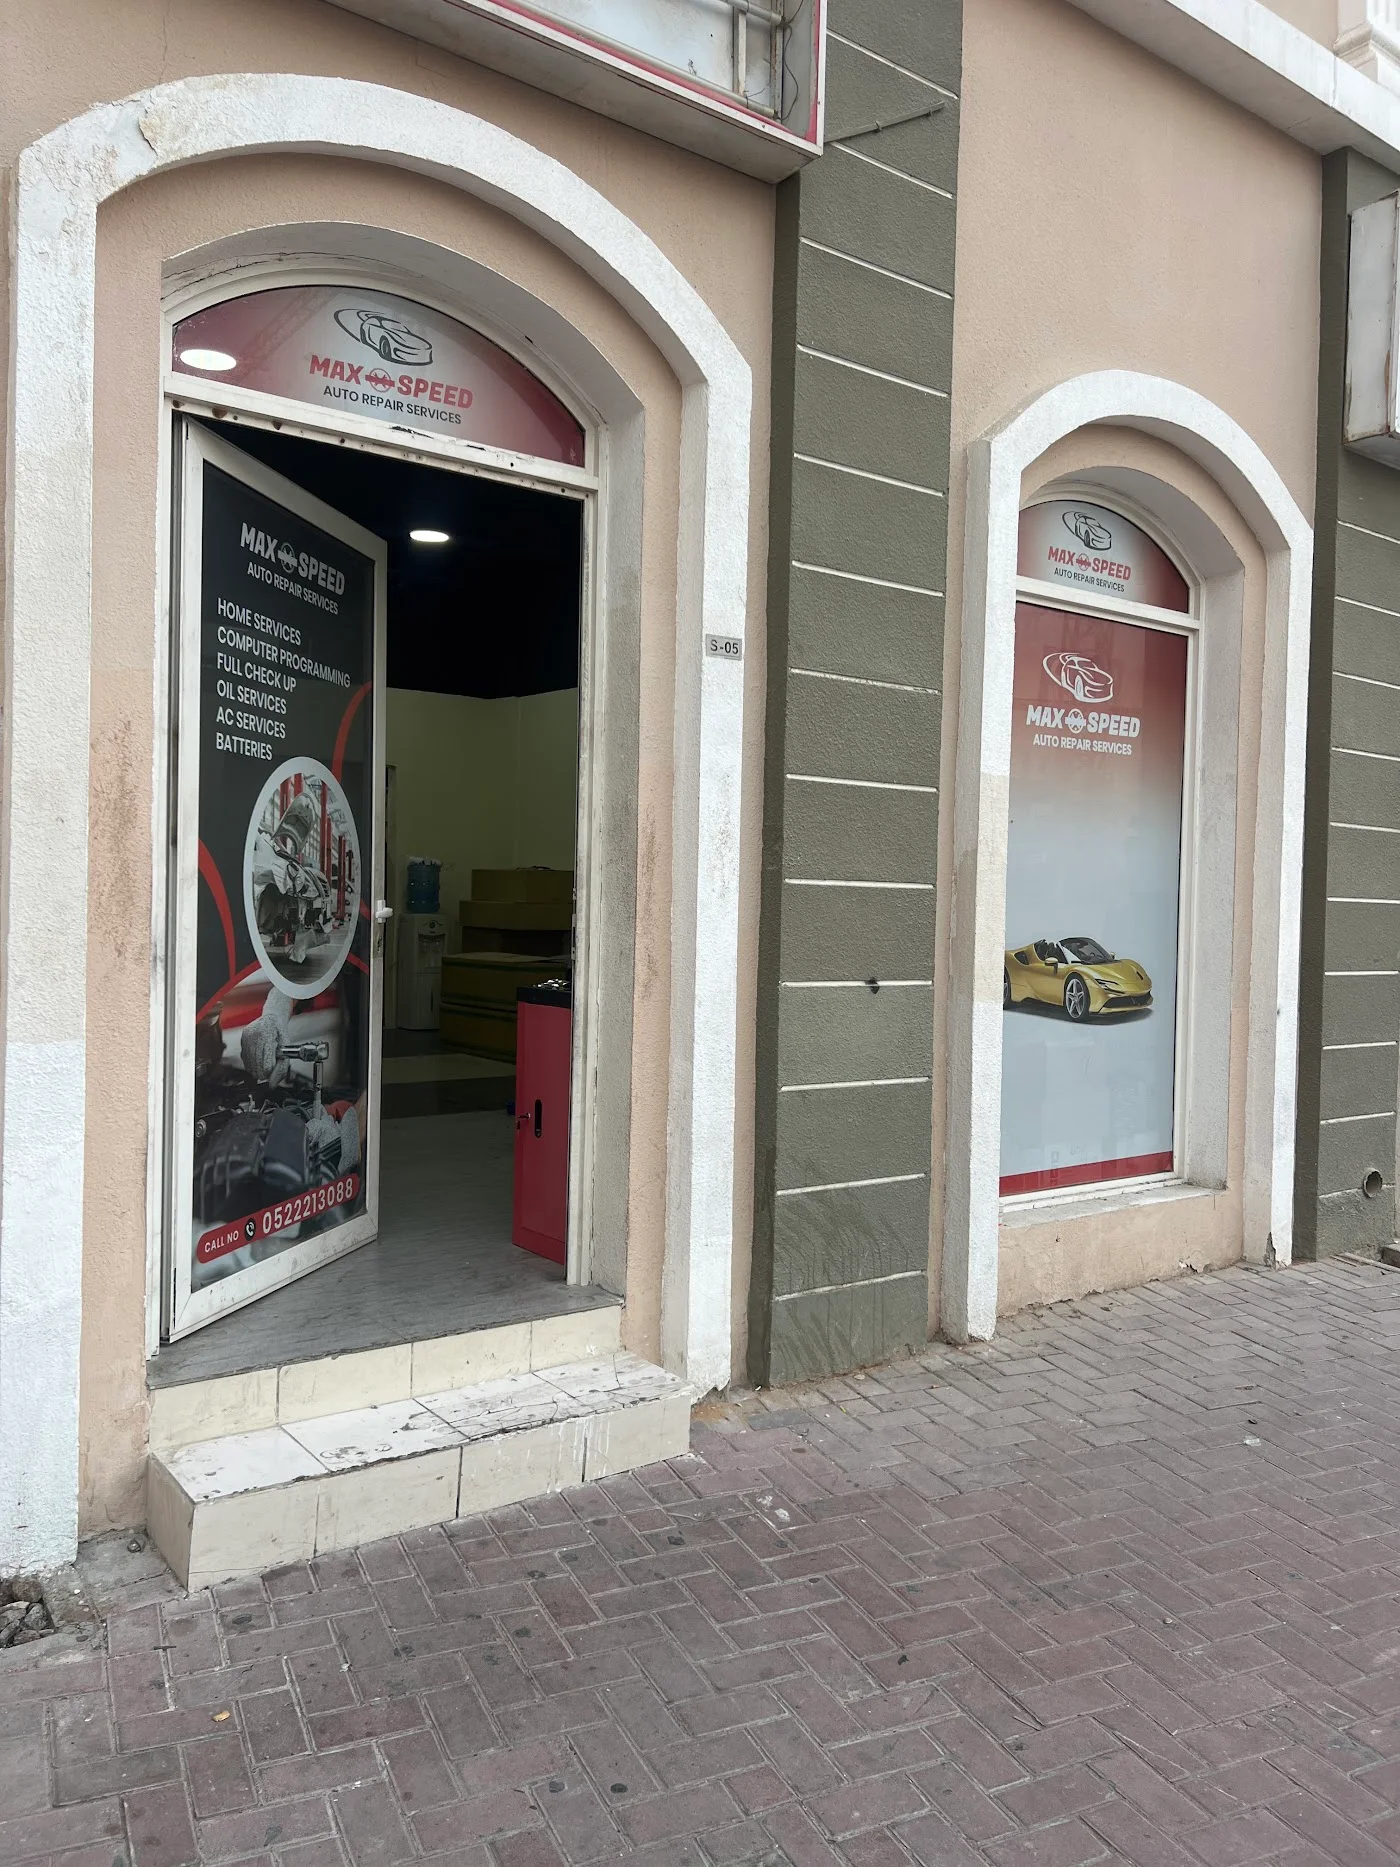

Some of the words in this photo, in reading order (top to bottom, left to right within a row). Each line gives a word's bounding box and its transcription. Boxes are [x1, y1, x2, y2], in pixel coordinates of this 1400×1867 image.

[309, 354, 364, 385] MAX
[397, 374, 473, 409] SPEED
[323, 385, 358, 403] AUTO
[362, 393, 403, 412] REPAIR
[406, 403, 461, 424] SERVICES
[240, 523, 278, 562] MAX
[298, 552, 345, 596] SPEED
[1048, 546, 1074, 566] MAX
[1091, 557, 1131, 581] SPEED
[247, 562, 272, 584] AUTO
[274, 574, 302, 600] REPAIR
[303, 588, 338, 615] SERVICES
[1054, 567, 1072, 579] AUTO
[1074, 572, 1095, 585] REPAIR
[1096, 578, 1124, 592] SERVICES
[218, 598, 251, 626] HOME
[254, 613, 301, 646] SERVICES
[218, 626, 278, 662] COMPUTER
[280, 648, 351, 689] PROGRAMMING
[711, 640, 738, 654] S-05
[217, 652, 242, 676] FULL
[244, 663, 280, 689] CHECK
[283, 676, 296, 693] UP
[217, 680, 235, 700] OIL
[237, 687, 286, 715] SERVICES
[216, 706, 234, 726] AC
[236, 711, 286, 739] SERVICES
[1026, 705, 1065, 729] MAX
[1087, 712, 1140, 738] SPEED
[216, 732, 272, 760] BATTERIES
[1033, 734, 1059, 748] AUTO
[1061, 737, 1091, 751] REPAIR
[1092, 741, 1132, 755] SERVICES
[205, 1239, 225, 1253] CALL
[227, 1230, 239, 1243] NO
[262, 1178, 353, 1234] 0522213088
